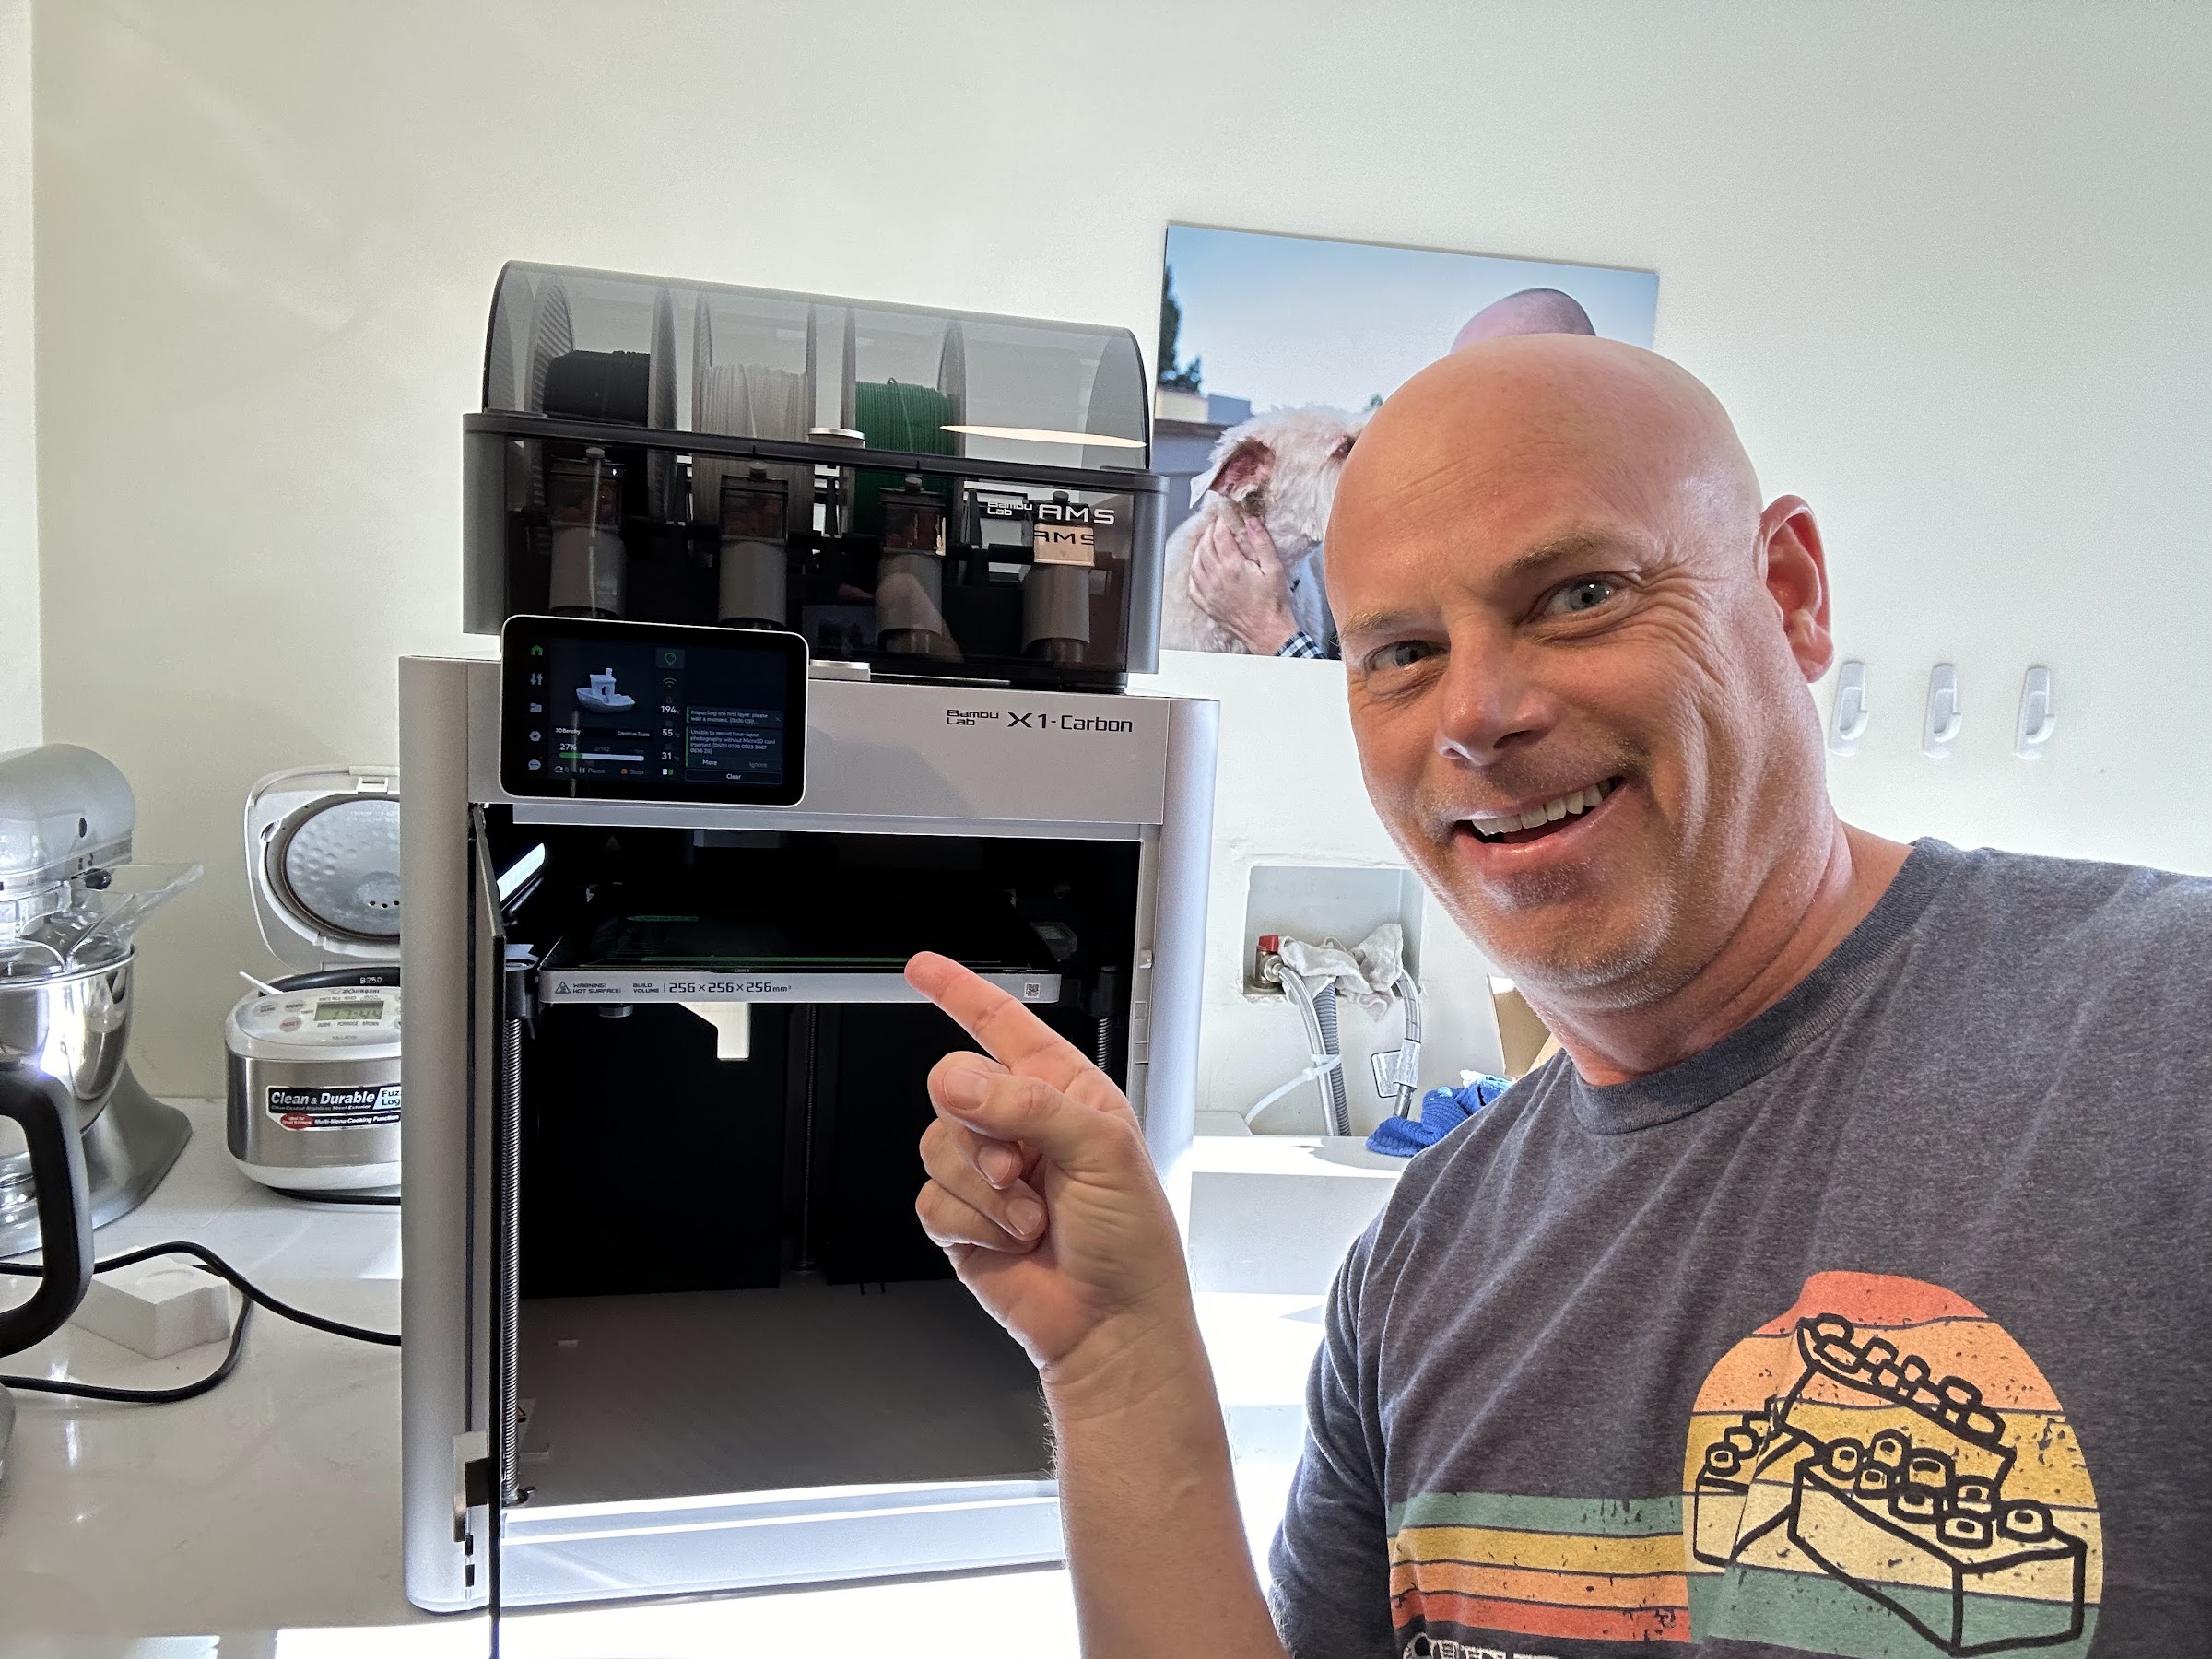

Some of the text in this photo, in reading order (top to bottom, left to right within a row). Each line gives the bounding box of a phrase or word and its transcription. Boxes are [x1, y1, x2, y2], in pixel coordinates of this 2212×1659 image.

[987, 501, 1032, 511] Bambu
[987, 507, 1012, 515] Lab
[1039, 504, 1114, 524] AMS
[661, 705, 677, 713] 194
[947, 709, 999, 719] Bambu
[947, 717, 975, 726] Lab
[662, 728, 673, 736] 55
[559, 743, 577, 751] 27%
[661, 751, 672, 759] 31
[271, 1091, 375, 1105] Clean & Durable
[382, 1089, 401, 1098] Fuz
[372, 1113, 400, 1122] Function
